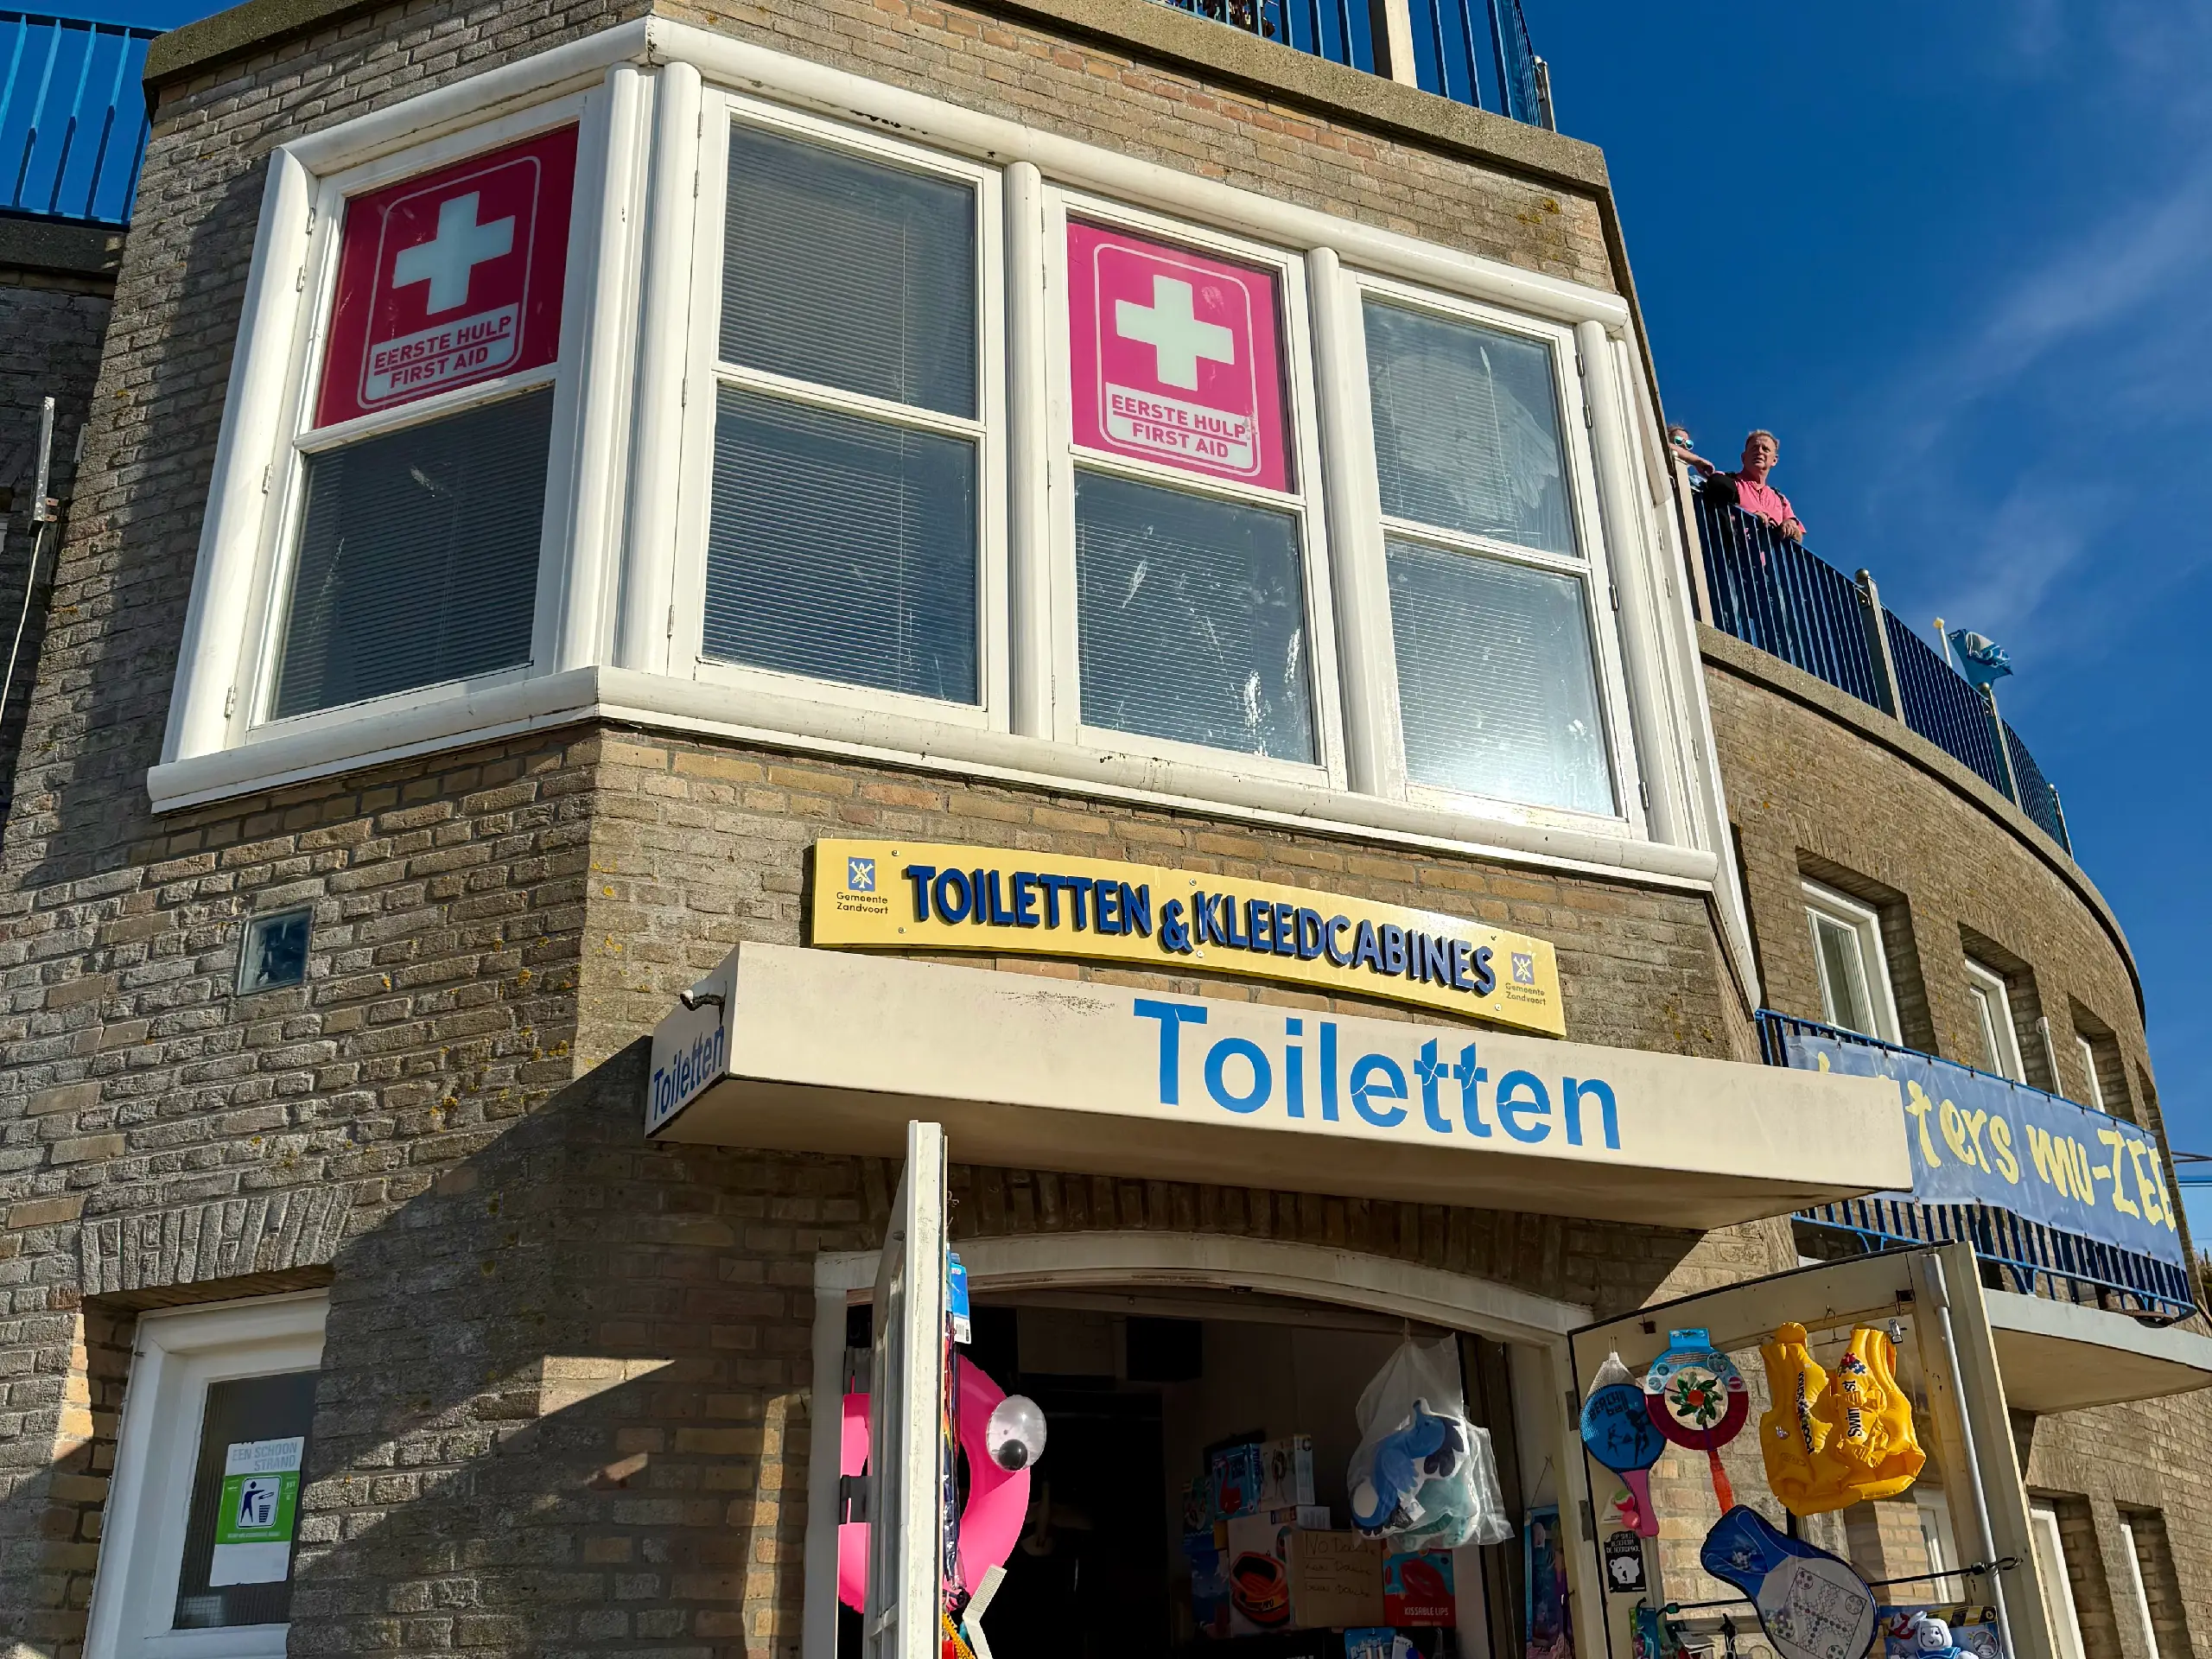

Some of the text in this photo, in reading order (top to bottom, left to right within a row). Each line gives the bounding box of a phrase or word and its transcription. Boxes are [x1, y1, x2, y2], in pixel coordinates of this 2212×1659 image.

[374, 315, 512, 370] EERSTE HULP
[390, 346, 488, 389] FIRST AID
[1112, 394, 1245, 438] EERSTE HULP
[1133, 422, 1229, 458] FIRST AID
[836, 892, 888, 904] Gemeente
[836, 901, 888, 914] Zandvoort
[906, 865, 1497, 995] TOILETTEN & KLEEDCABINES
[1505, 982, 1545, 995] Gemeente
[1505, 991, 1546, 1006] Zandvoort
[654, 1025, 725, 1121] Toiletten
[1134, 999, 1621, 1150] Toiletten
[1877, 1074, 2018, 1185] ters
[232, 1441, 297, 1461] EEN SCHOON
[254, 1455, 296, 1471] STRAND
[1404, 1606, 1449, 1617] KISSABLE LIPS
